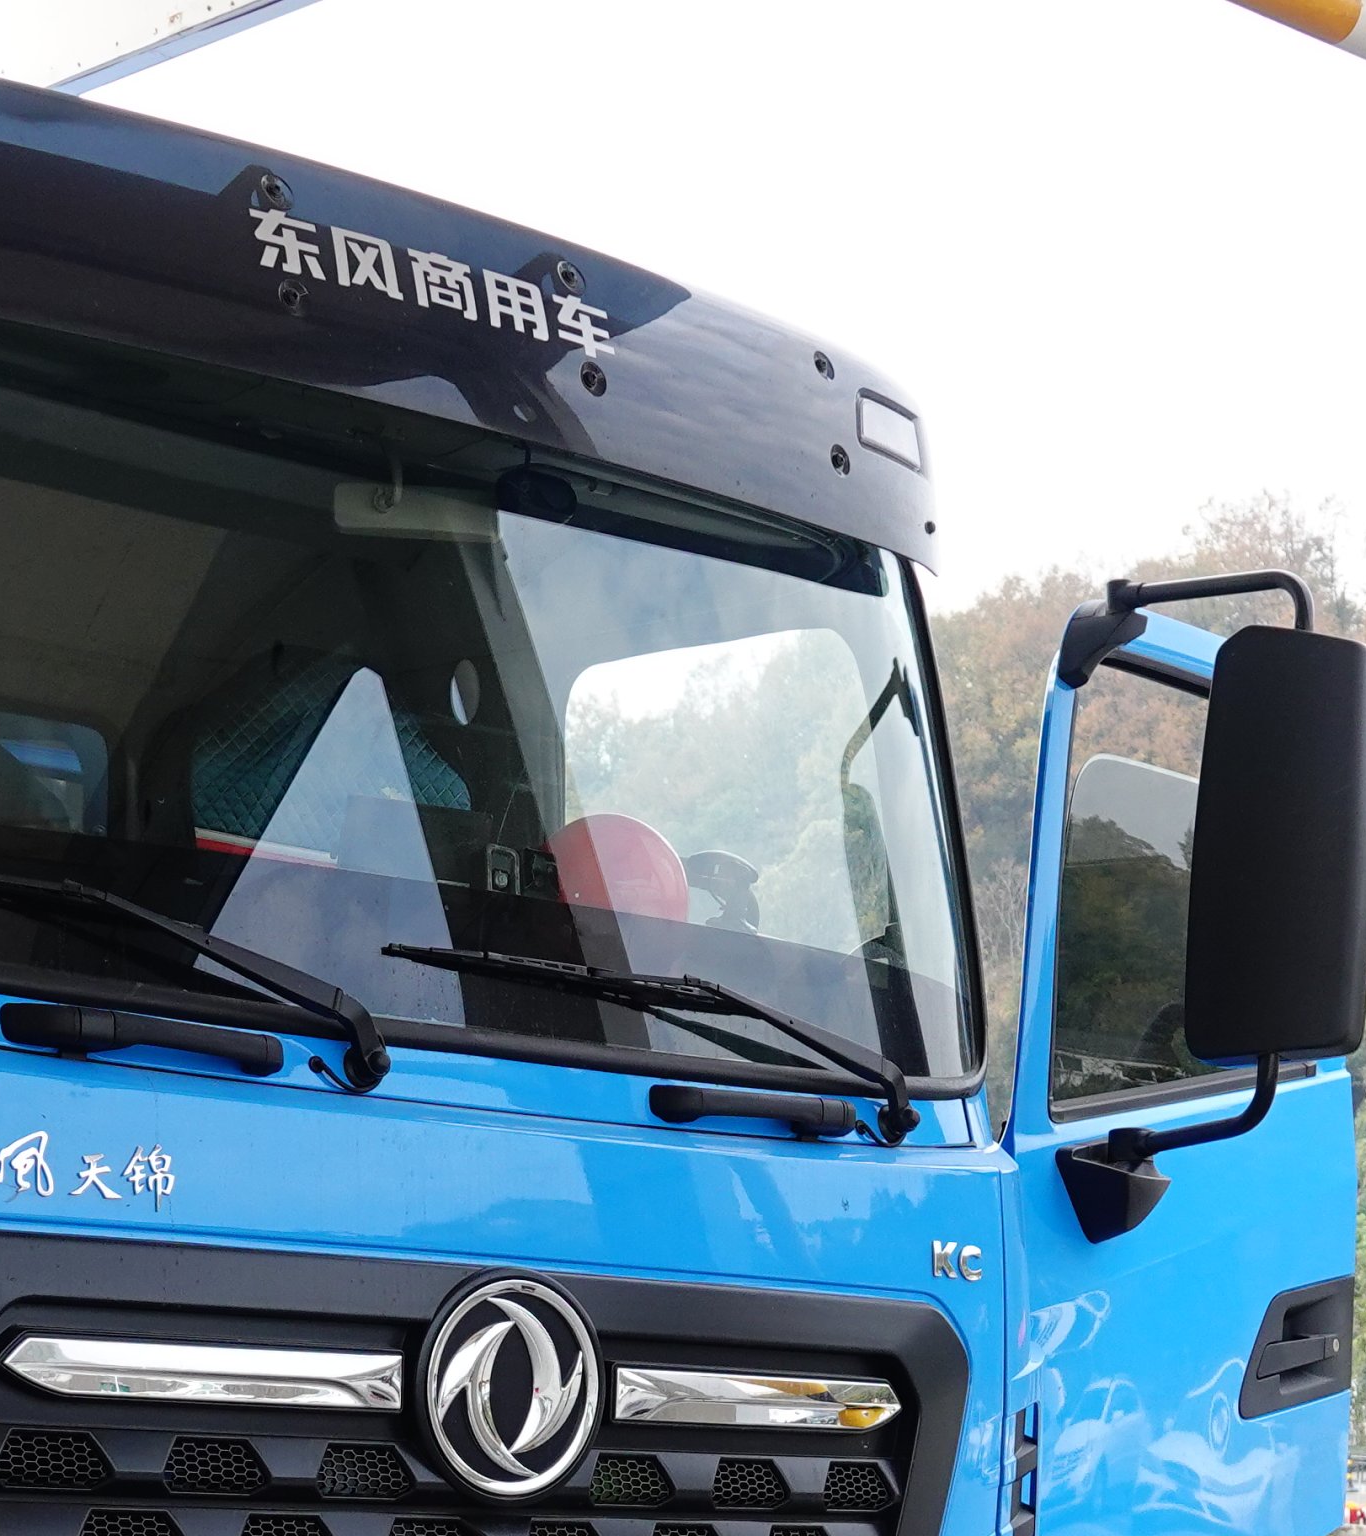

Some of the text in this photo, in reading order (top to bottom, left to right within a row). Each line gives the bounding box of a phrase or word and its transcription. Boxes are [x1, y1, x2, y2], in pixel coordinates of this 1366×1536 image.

[249, 208, 616, 358] 东风商用车
[68, 1143, 176, 1213] 天锦
[932, 1240, 982, 1281] KC
